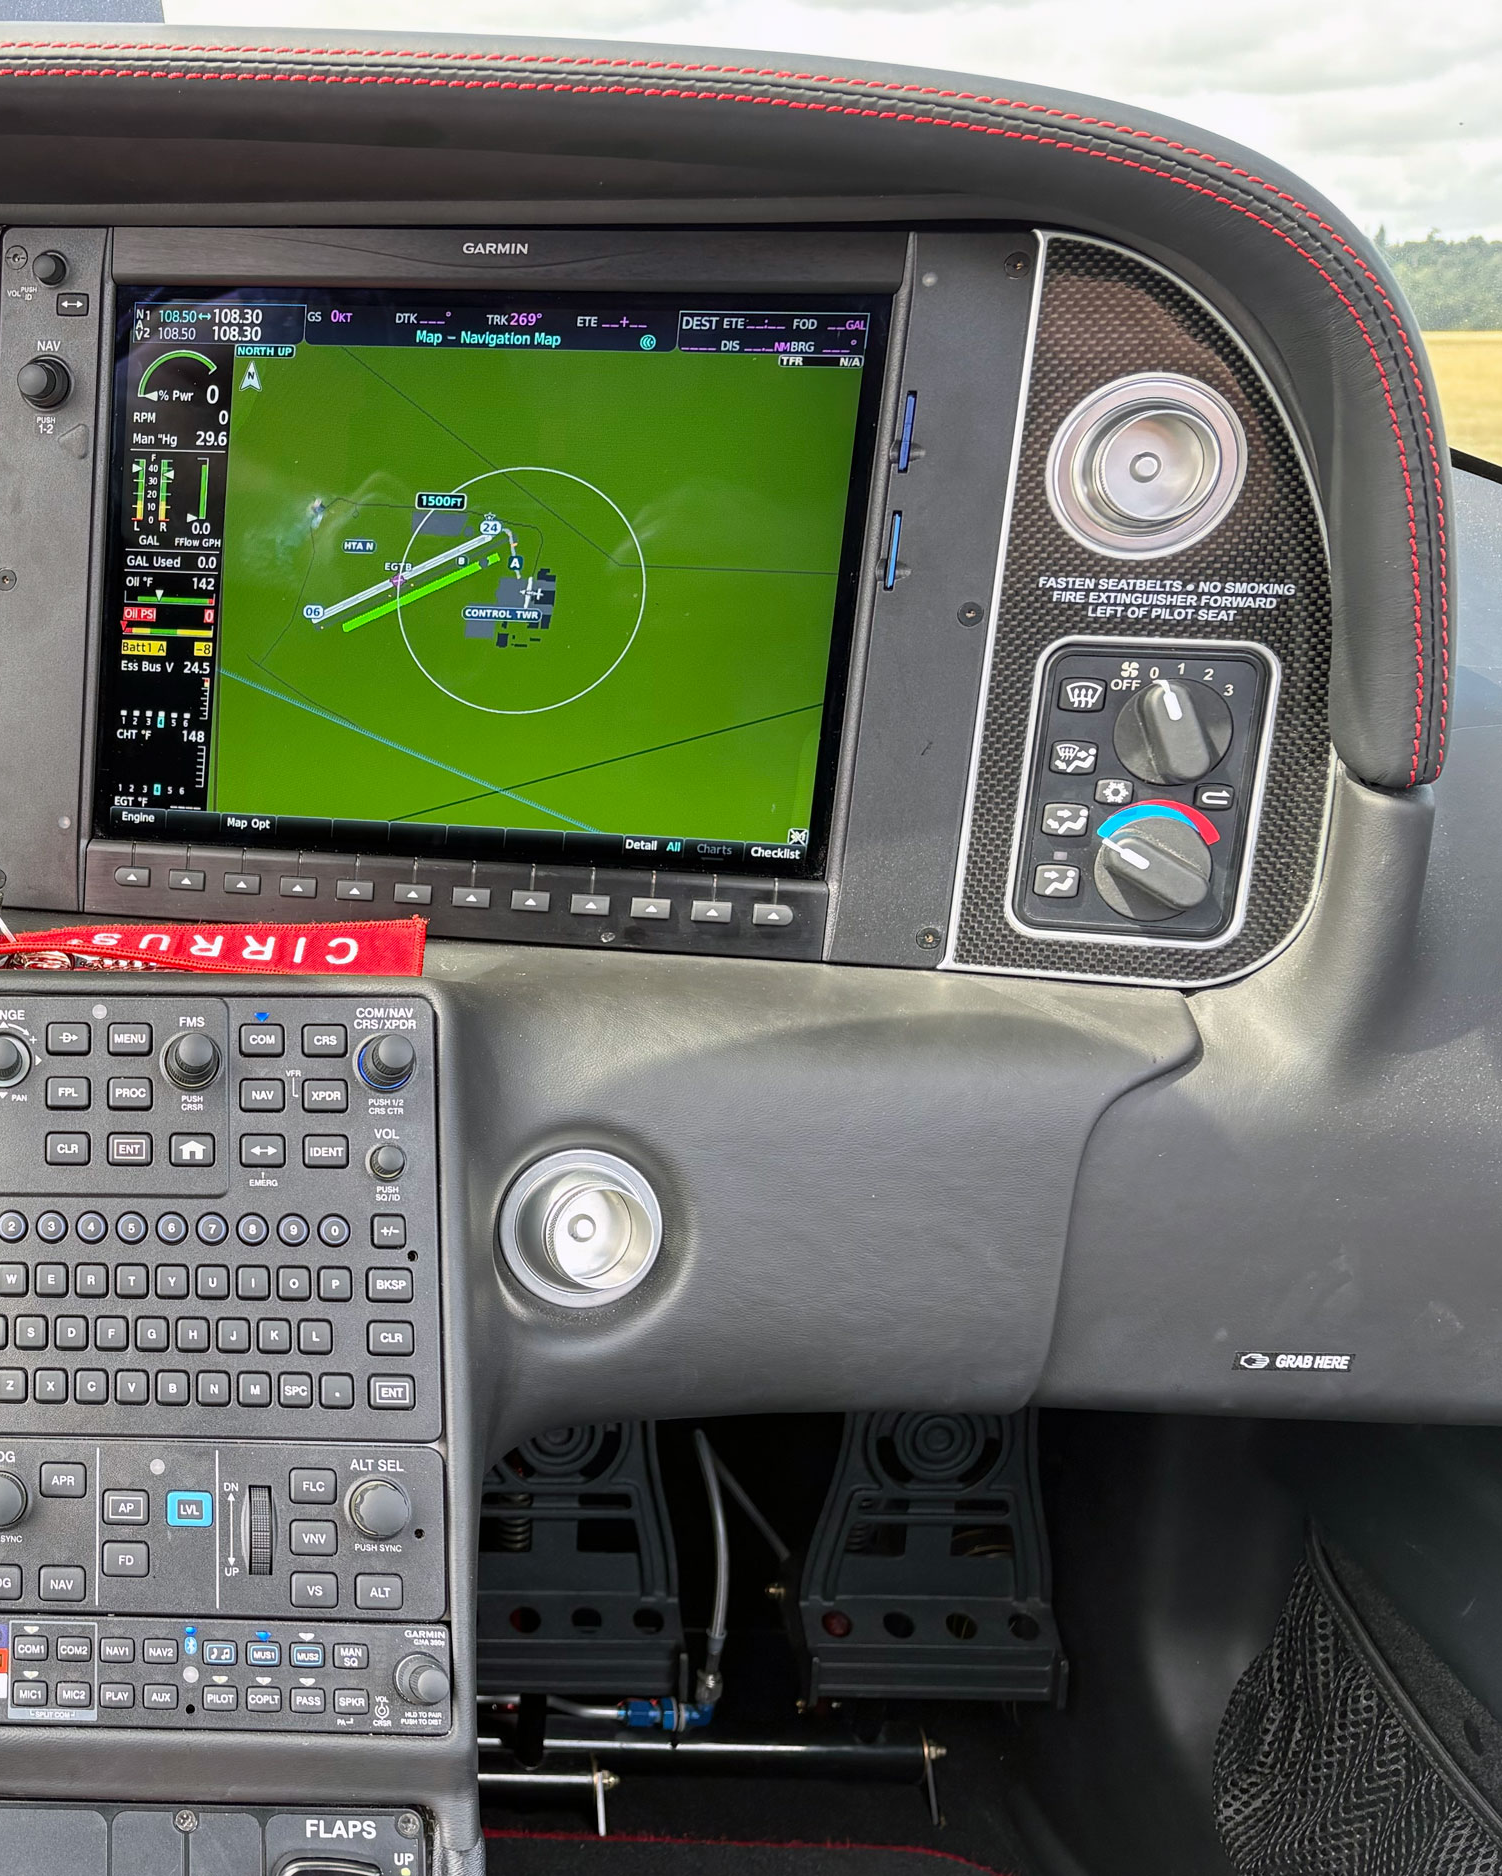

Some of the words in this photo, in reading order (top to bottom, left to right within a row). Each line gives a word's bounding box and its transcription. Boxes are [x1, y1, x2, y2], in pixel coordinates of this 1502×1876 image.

[463, 243, 528, 254] GARMIN
[159, 311, 196, 322] 108.50
[214, 309, 262, 324] 108.30
[683, 317, 719, 329] DEST
[158, 327, 195, 339] 108.50
[212, 326, 261, 341] 108.30
[416, 331, 442, 345] Map
[461, 331, 530, 346] Navigation
[534, 333, 561, 348] Map
[37, 341, 60, 351] NAV
[238, 347, 274, 356] NORTH
[277, 347, 292, 356] UP
[782, 357, 803, 366] TFR
[840, 358, 860, 366] N/A
[134, 413, 155, 423] RPM
[133, 434, 154, 444] Man
[196, 432, 227, 445] 29.6
[127, 556, 149, 566] GAL
[154, 557, 180, 567] Used
[198, 557, 216, 568] 0.0
[126, 577, 139, 586] Oil
[193, 578, 214, 590] 142
[1039, 577, 1095, 589] FASTEN
[1099, 579, 1182, 591] SEATBELTS
[1198, 582, 1221, 592] NO
[1225, 582, 1295, 595] SMOKING
[1053, 591, 1085, 602] FIRE
[1089, 593, 1197, 605] EXTINGUISHER
[1201, 596, 1276, 608] FORWARD
[466, 609, 511, 618] CONTROL
[516, 611, 538, 620] TWR
[1088, 607, 1124, 617] LEFT
[1128, 608, 1147, 618] OF
[1151, 608, 1194, 619] PILOT
[1198, 610, 1236, 621] SEAT
[121, 662, 138, 671] Ess
[142, 662, 161, 672] Bus
[166, 663, 173, 672] V
[184, 662, 210, 673] 24.5
[1111, 680, 1141, 691] OFF
[182, 731, 204, 741] 148
[122, 813, 154, 822] Engine
[227, 818, 247, 829] Map
[252, 819, 270, 829] Opt
[626, 840, 657, 850] Detail
[667, 842, 681, 851] All
[697, 844, 732, 855] Charts
[751, 847, 800, 859] Checklist
[91, 932, 358, 965] CIRRUS
[356, 1008, 413, 1018] COM/NAV
[180, 1017, 205, 1027] FMS
[354, 1020, 416, 1030] CRS/XPDR
[115, 1034, 146, 1043] MENU
[250, 1036, 275, 1044] COM
[314, 1036, 337, 1045] CRS
[59, 1088, 77, 1097] FPL
[116, 1088, 146, 1098] PROC
[252, 1091, 274, 1100] NAV
[312, 1092, 340, 1101] XPDR
[374, 1130, 400, 1139] VOL
[57, 1144, 78, 1154] CLR
[119, 1145, 140, 1154] ENT
[310, 1148, 343, 1156] IDENT
[377, 1280, 406, 1289] BKSP
[1276, 1355, 1313, 1368] GRAB
[1314, 1356, 1350, 1369] HERE
[351, 1460, 374, 1471] ALT
[378, 1461, 404, 1471] SEL
[52, 1476, 74, 1485] APR
[303, 1482, 325, 1491] FLC
[181, 1505, 199, 1515] LVL
[370, 1588, 390, 1597] ALT
[405, 1630, 445, 1638] GARMIN
[18, 1645, 44, 1654] COM1
[61, 1646, 87, 1654] COM2
[106, 1692, 128, 1701] PLAY
[208, 1694, 234, 1703] PILOT
[297, 1697, 320, 1705] PASS
[339, 1697, 364, 1706] SPKR
[306, 1820, 376, 1839] FLAPS
[394, 1853, 414, 1865] UP
